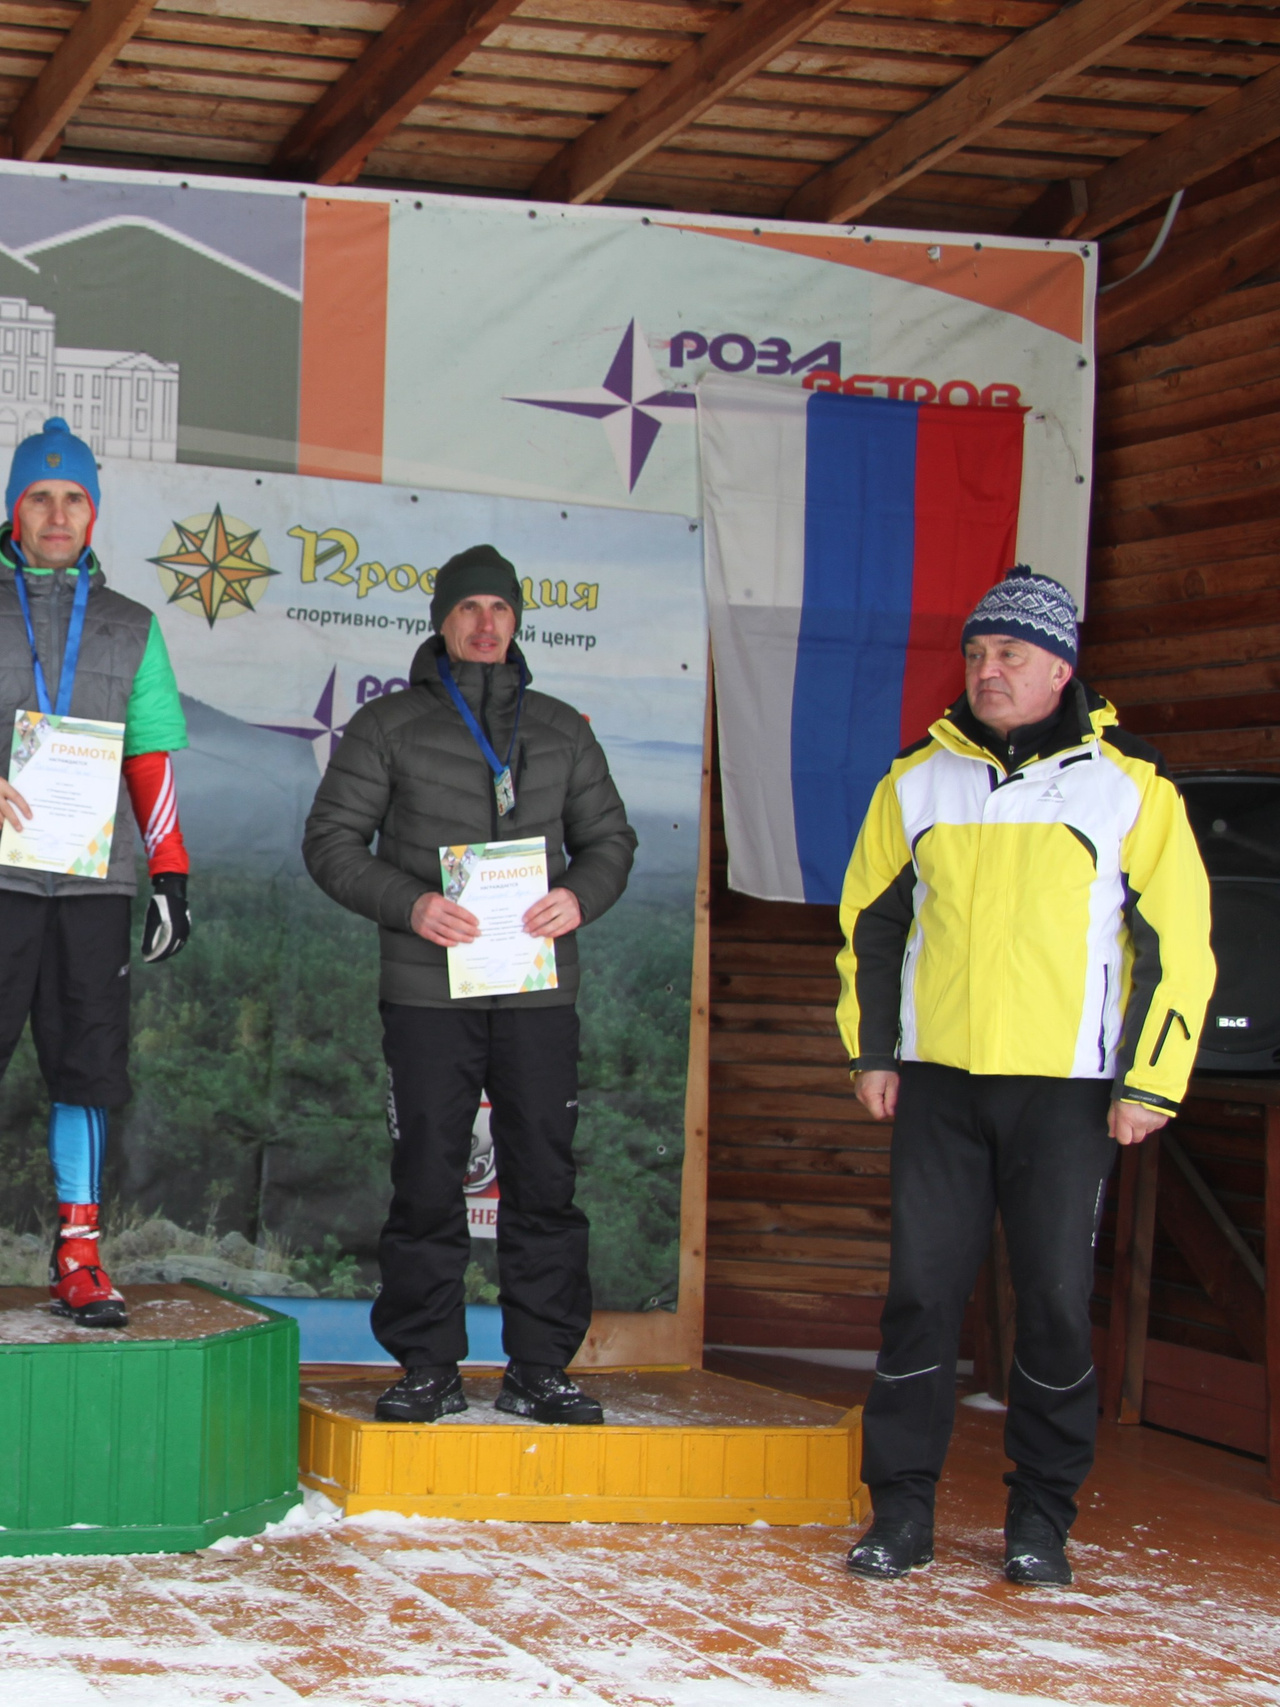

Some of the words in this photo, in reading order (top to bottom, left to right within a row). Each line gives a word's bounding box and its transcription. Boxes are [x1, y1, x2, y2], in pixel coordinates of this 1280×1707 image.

[669, 331, 841, 375] РОЗА
[542, 628, 596, 651] центр
[50, 743, 118, 761] ГРАМОТА
[480, 865, 544, 882] ГРАМОТА
[1218, 1018, 1248, 1028] B&G
